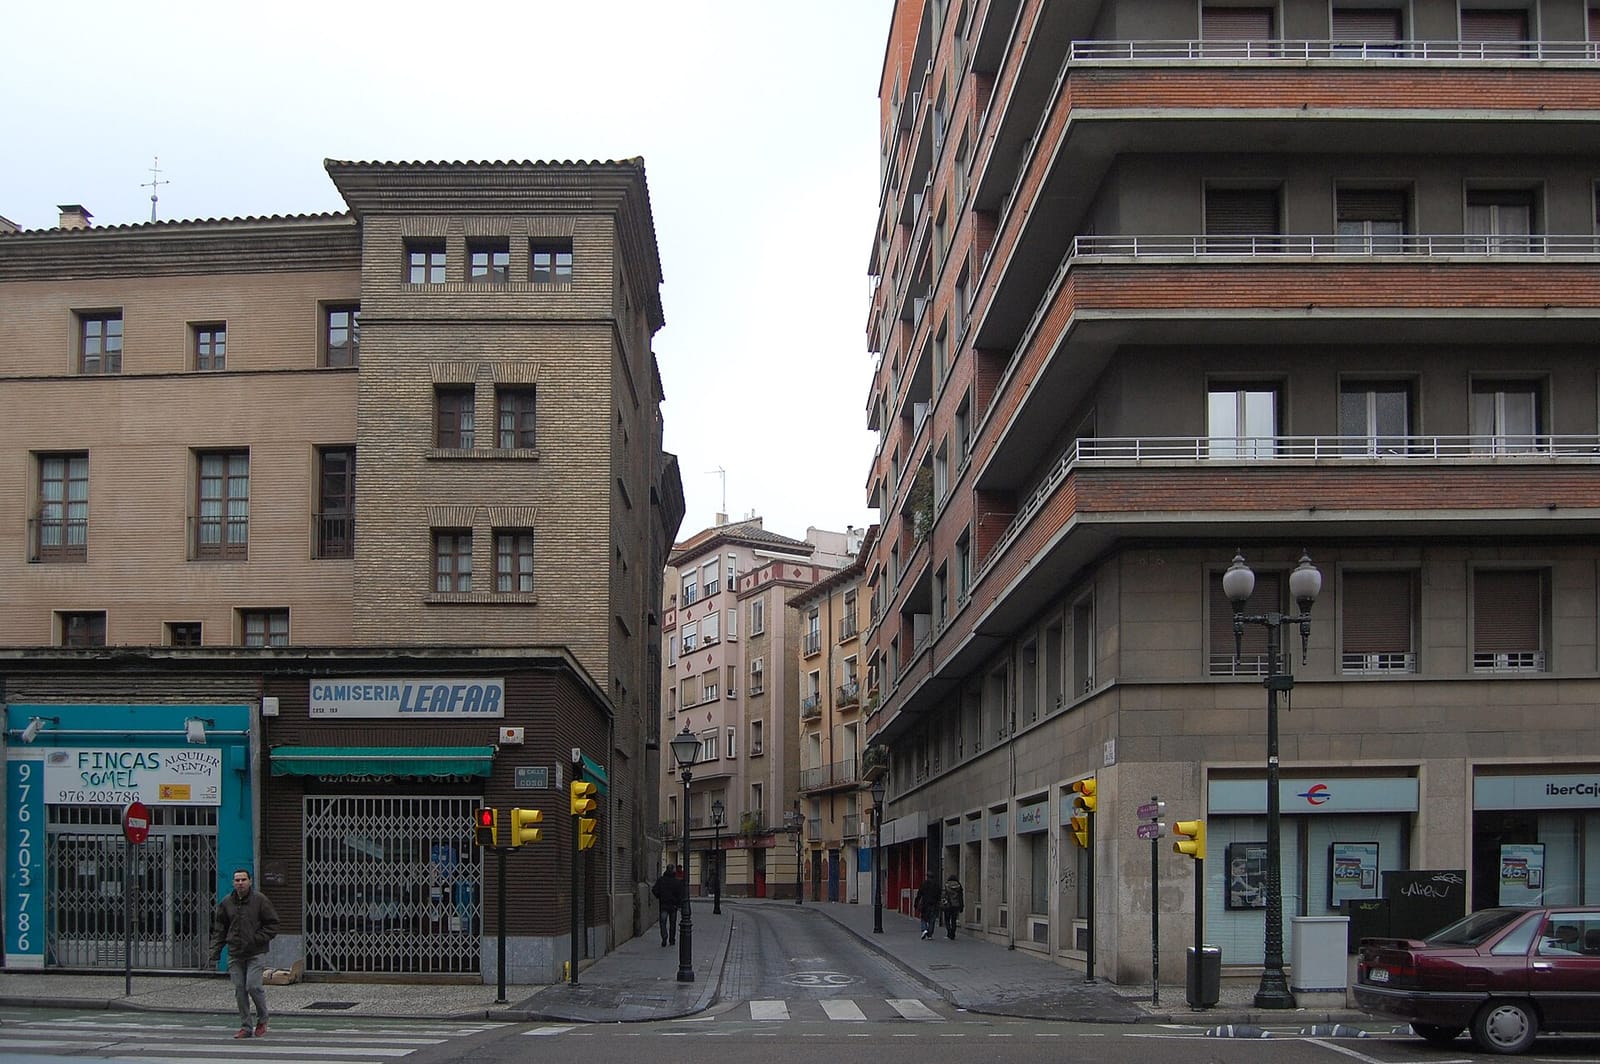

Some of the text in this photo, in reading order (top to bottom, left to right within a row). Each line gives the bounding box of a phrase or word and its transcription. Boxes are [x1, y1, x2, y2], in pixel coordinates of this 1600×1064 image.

[312, 685, 502, 713] CAMISERIA LEAFAR
[78, 752, 160, 769] FINCAS
[165, 751, 220, 768] ALQUILER
[171, 762, 213, 777] VENTA
[80, 769, 138, 789] SOMEL
[59, 791, 140, 802] 976 203786
[18, 764, 31, 950] 976 203 786
